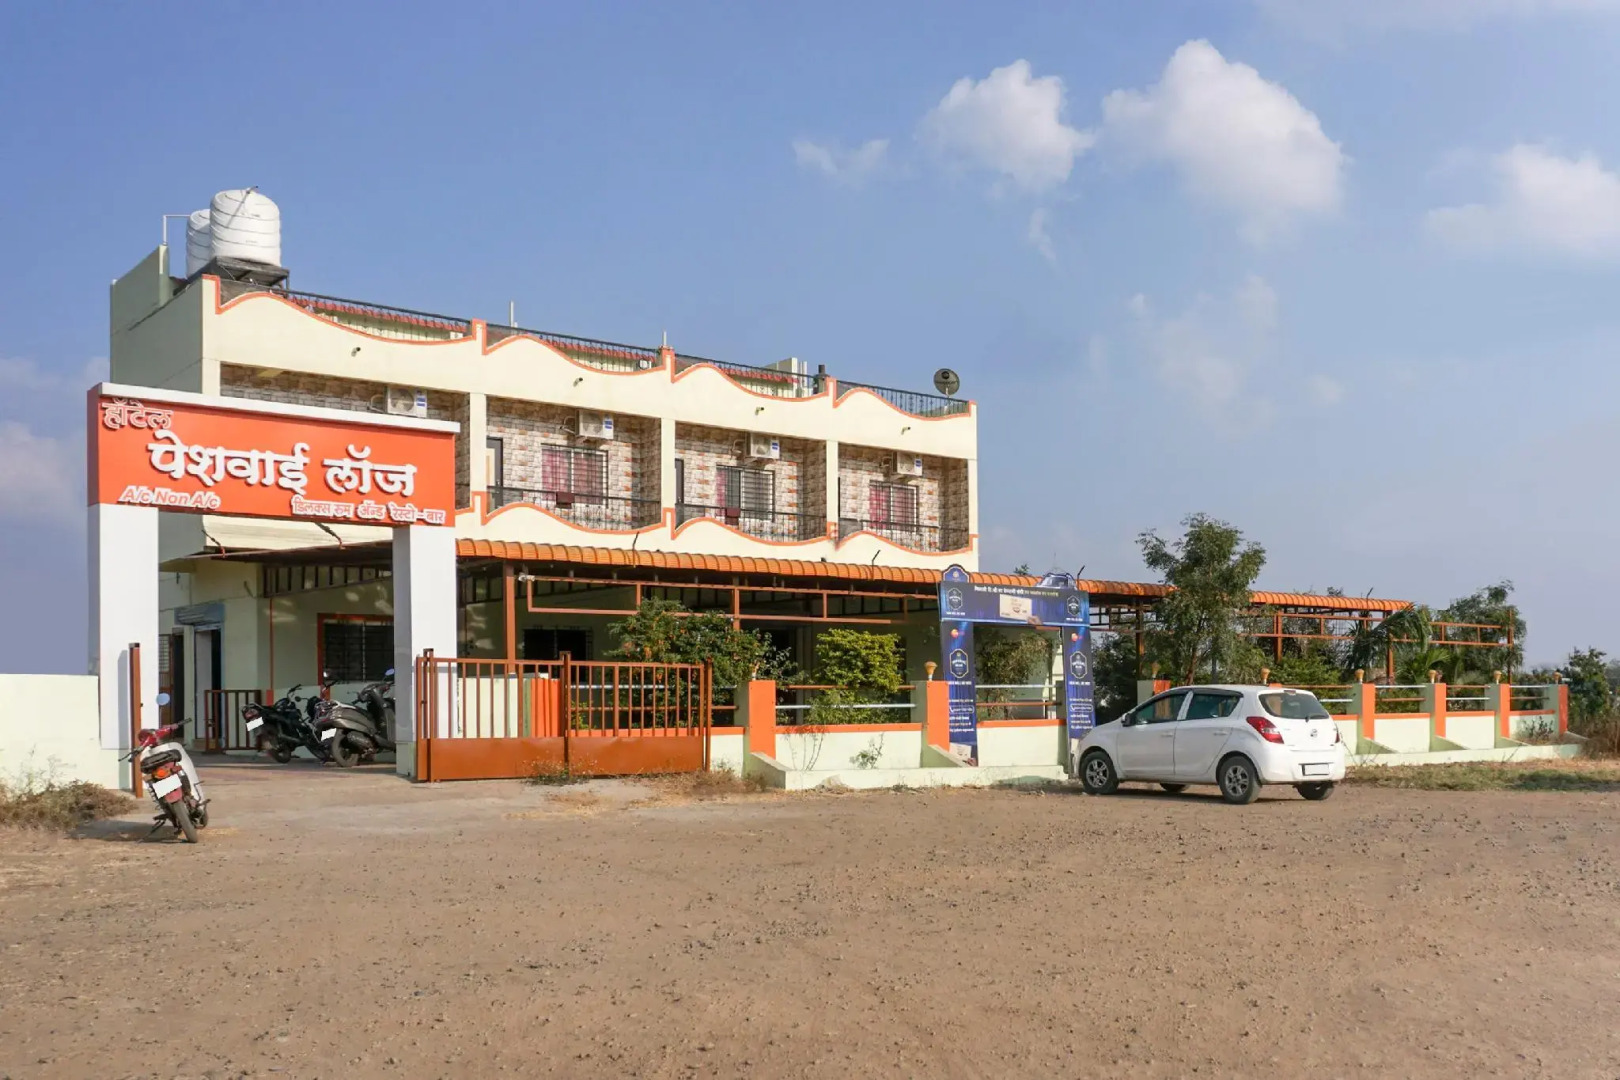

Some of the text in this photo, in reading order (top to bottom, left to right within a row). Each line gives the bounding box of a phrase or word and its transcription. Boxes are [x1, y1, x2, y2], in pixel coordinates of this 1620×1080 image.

[102, 397, 174, 429] हॉटेल
[147, 429, 418, 497] पेशवाई लॉज
[118, 485, 221, 509] A/c Non A/c
